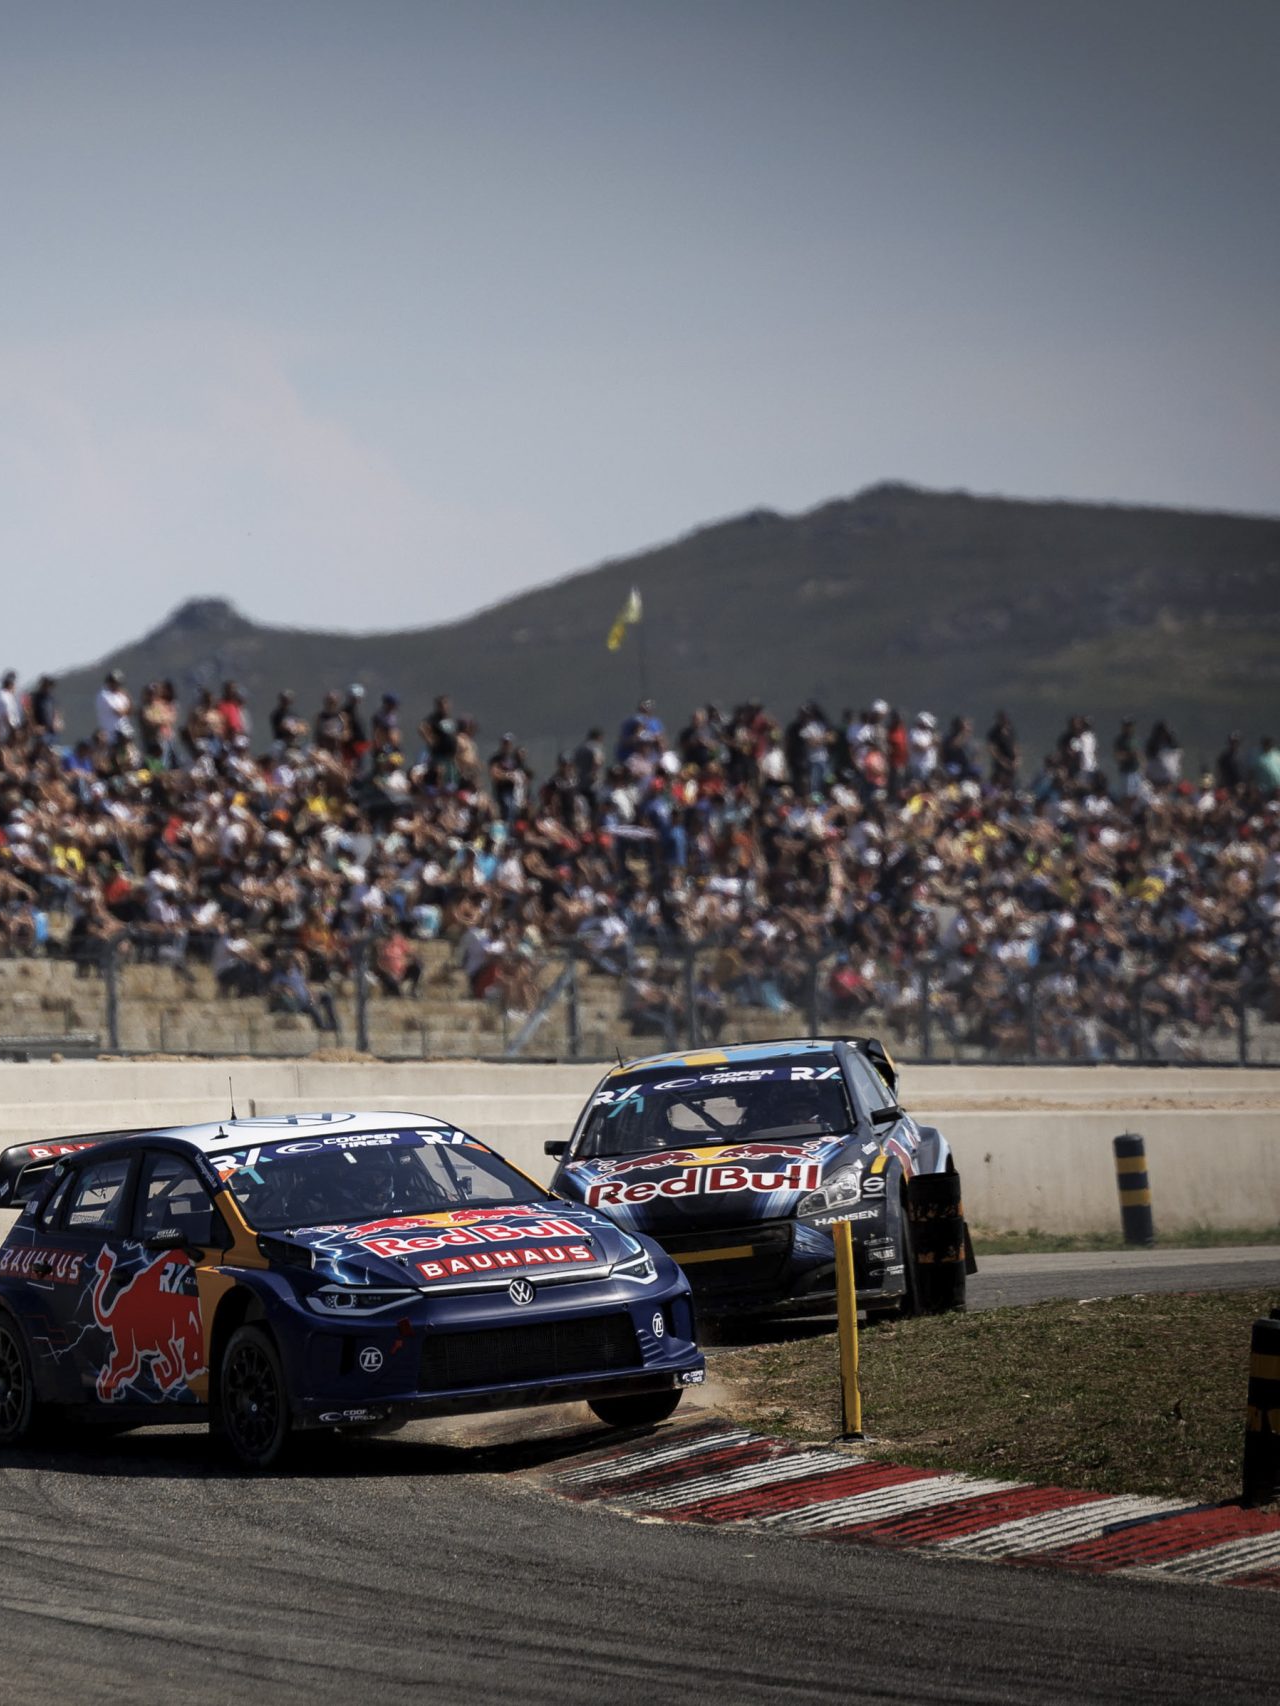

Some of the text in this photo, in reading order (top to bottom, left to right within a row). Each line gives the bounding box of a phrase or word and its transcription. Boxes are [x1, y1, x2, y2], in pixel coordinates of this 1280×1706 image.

[700, 1069, 775, 1081] COOPER
[710, 1076, 763, 1086] TIRES
[791, 1067, 842, 1081] RX
[593, 1084, 644, 1106] RX
[323, 1133, 400, 1146] COOPER
[337, 1139, 393, 1149] TIRES
[587, 1164, 822, 1208] Red Bull
[814, 1210, 879, 1226] HANSEN
[358, 1219, 591, 1258] Red Bull
[421, 1245, 590, 1278] BAUHAUS
[361, 1350, 382, 1369] ZF
